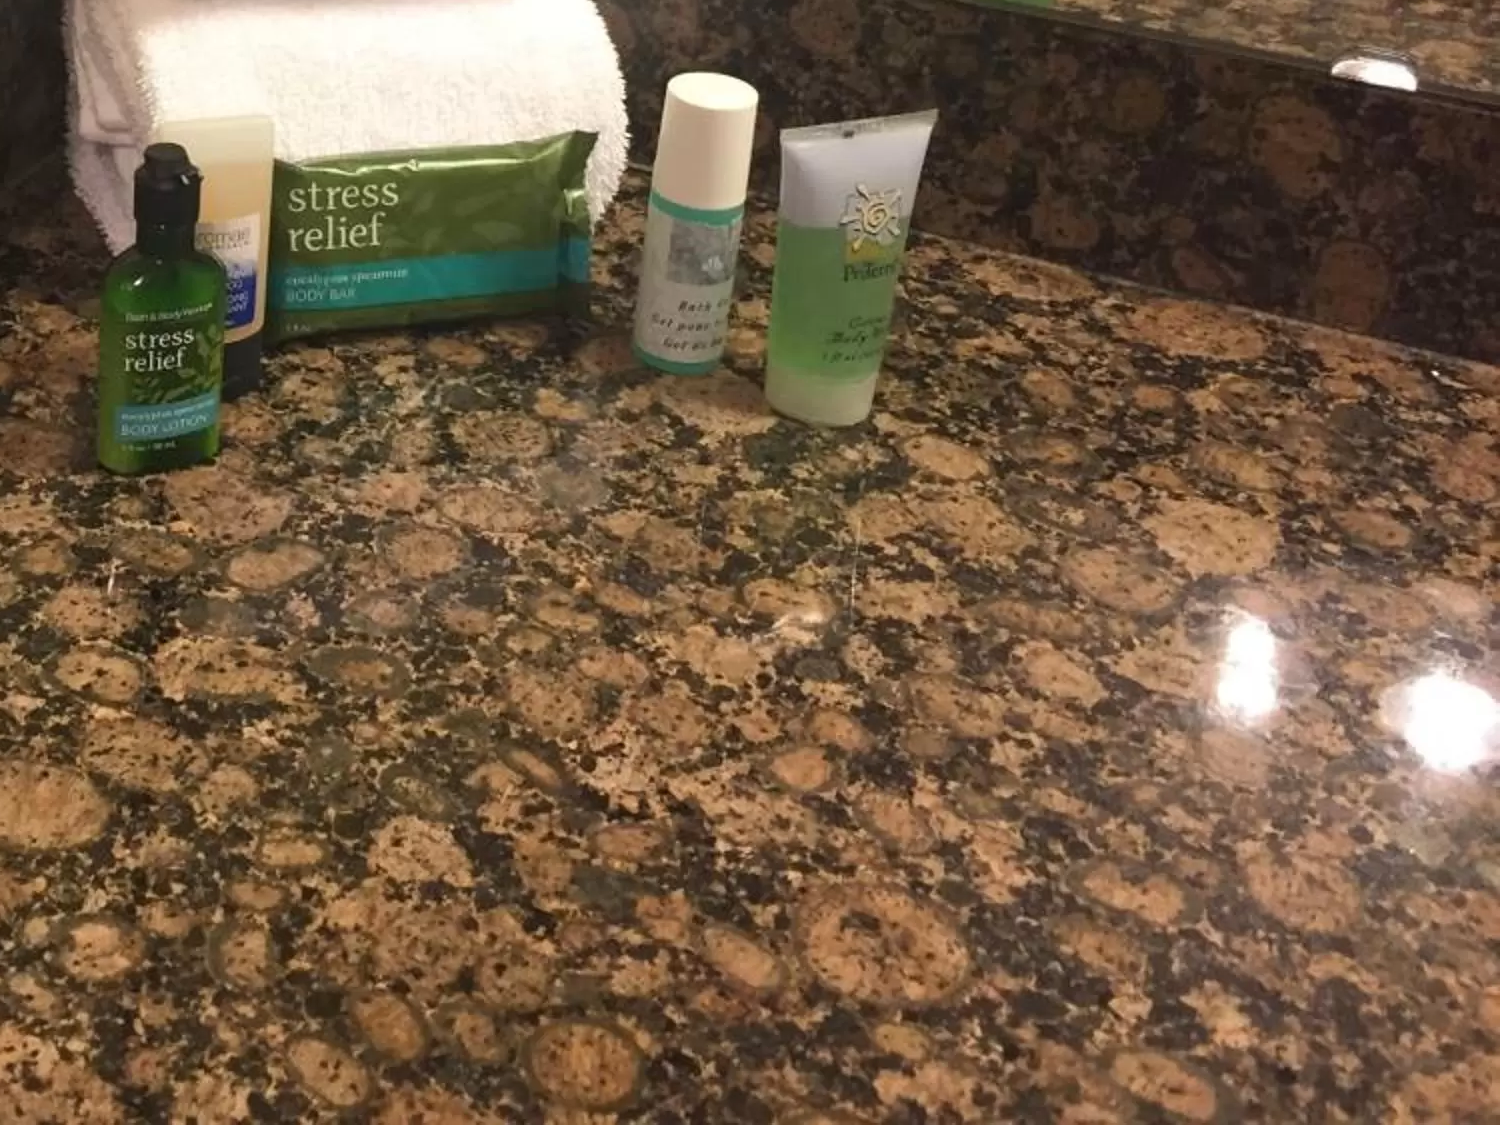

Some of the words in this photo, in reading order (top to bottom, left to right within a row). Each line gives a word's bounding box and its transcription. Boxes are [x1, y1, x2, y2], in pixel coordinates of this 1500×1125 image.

[287, 181, 399, 212] stress
[287, 211, 387, 252] relief
[286, 287, 325, 303] BODY
[125, 328, 195, 351] stress
[124, 346, 187, 372] relief
[121, 423, 159, 436] BODY
[161, 415, 208, 433] LOTION
